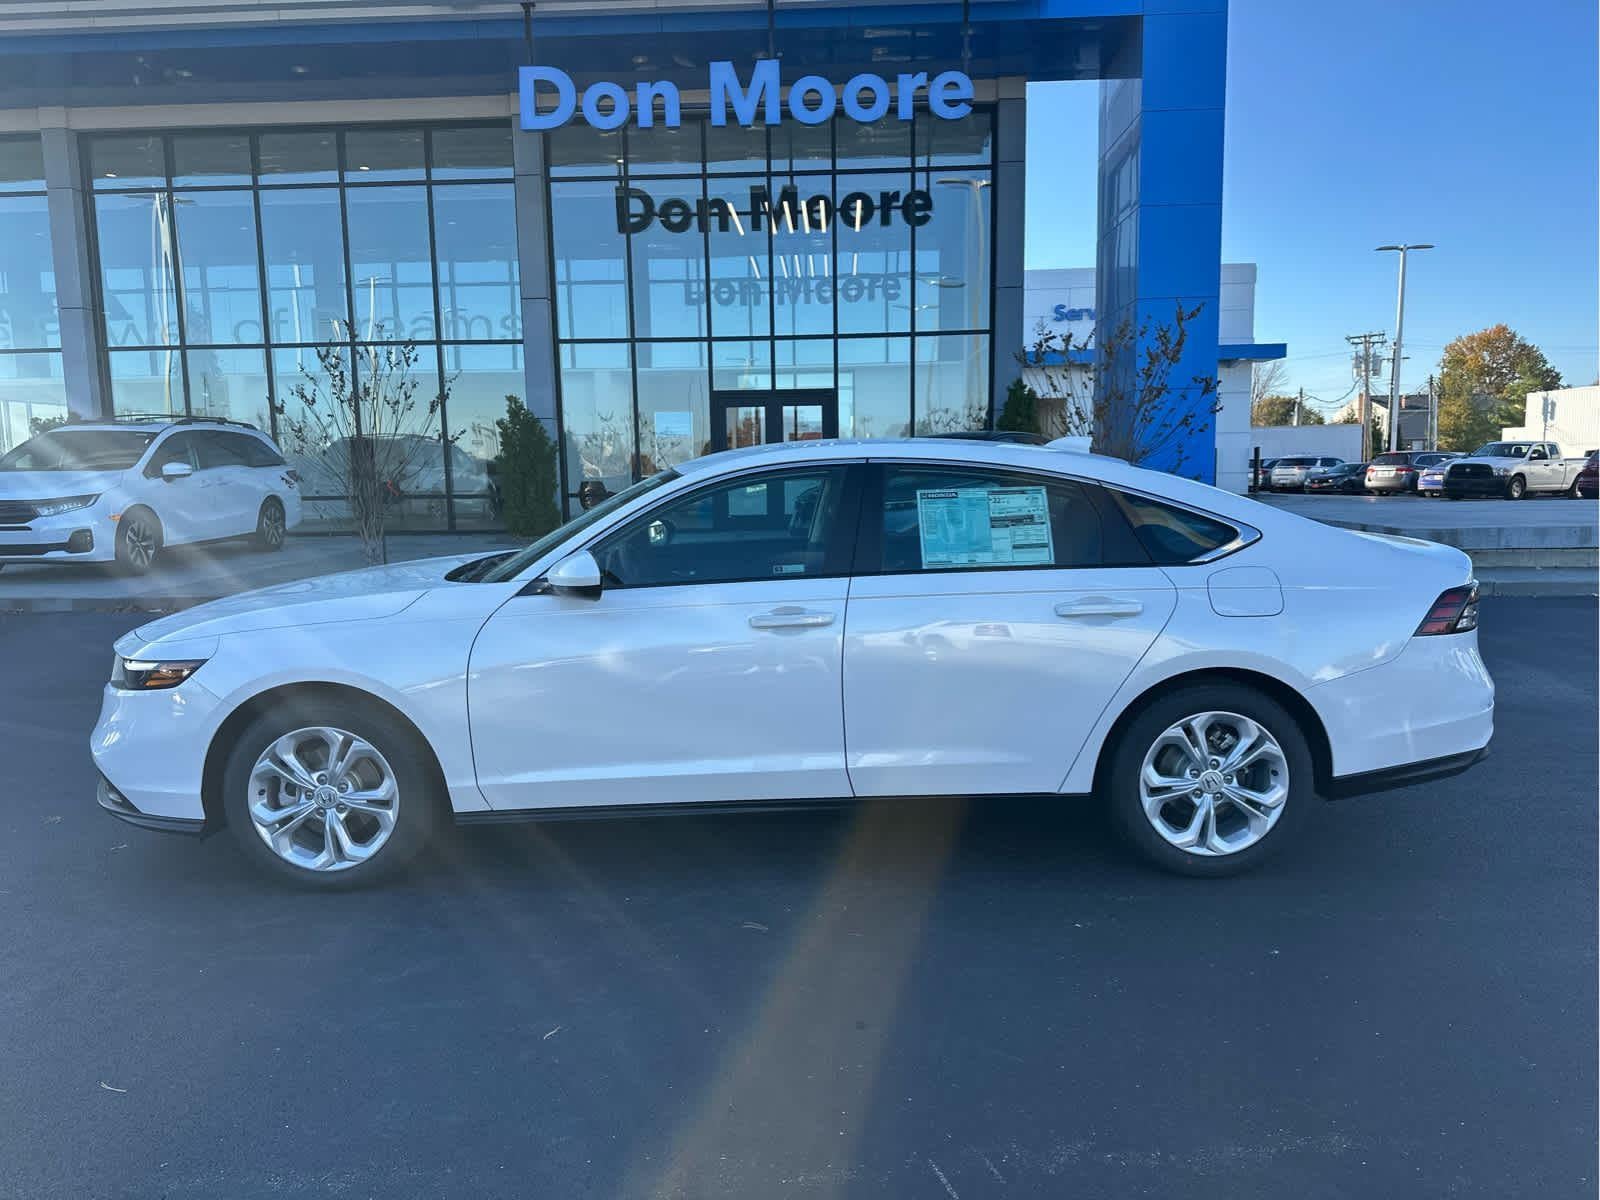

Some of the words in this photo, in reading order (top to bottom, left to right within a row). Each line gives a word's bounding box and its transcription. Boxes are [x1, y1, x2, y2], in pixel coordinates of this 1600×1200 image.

[519, 65, 681, 130] Don
[709, 58, 975, 127] Moore
[615, 186, 730, 233] Don
[749, 184, 933, 231] Moore
[776, 276, 901, 305] Moore
